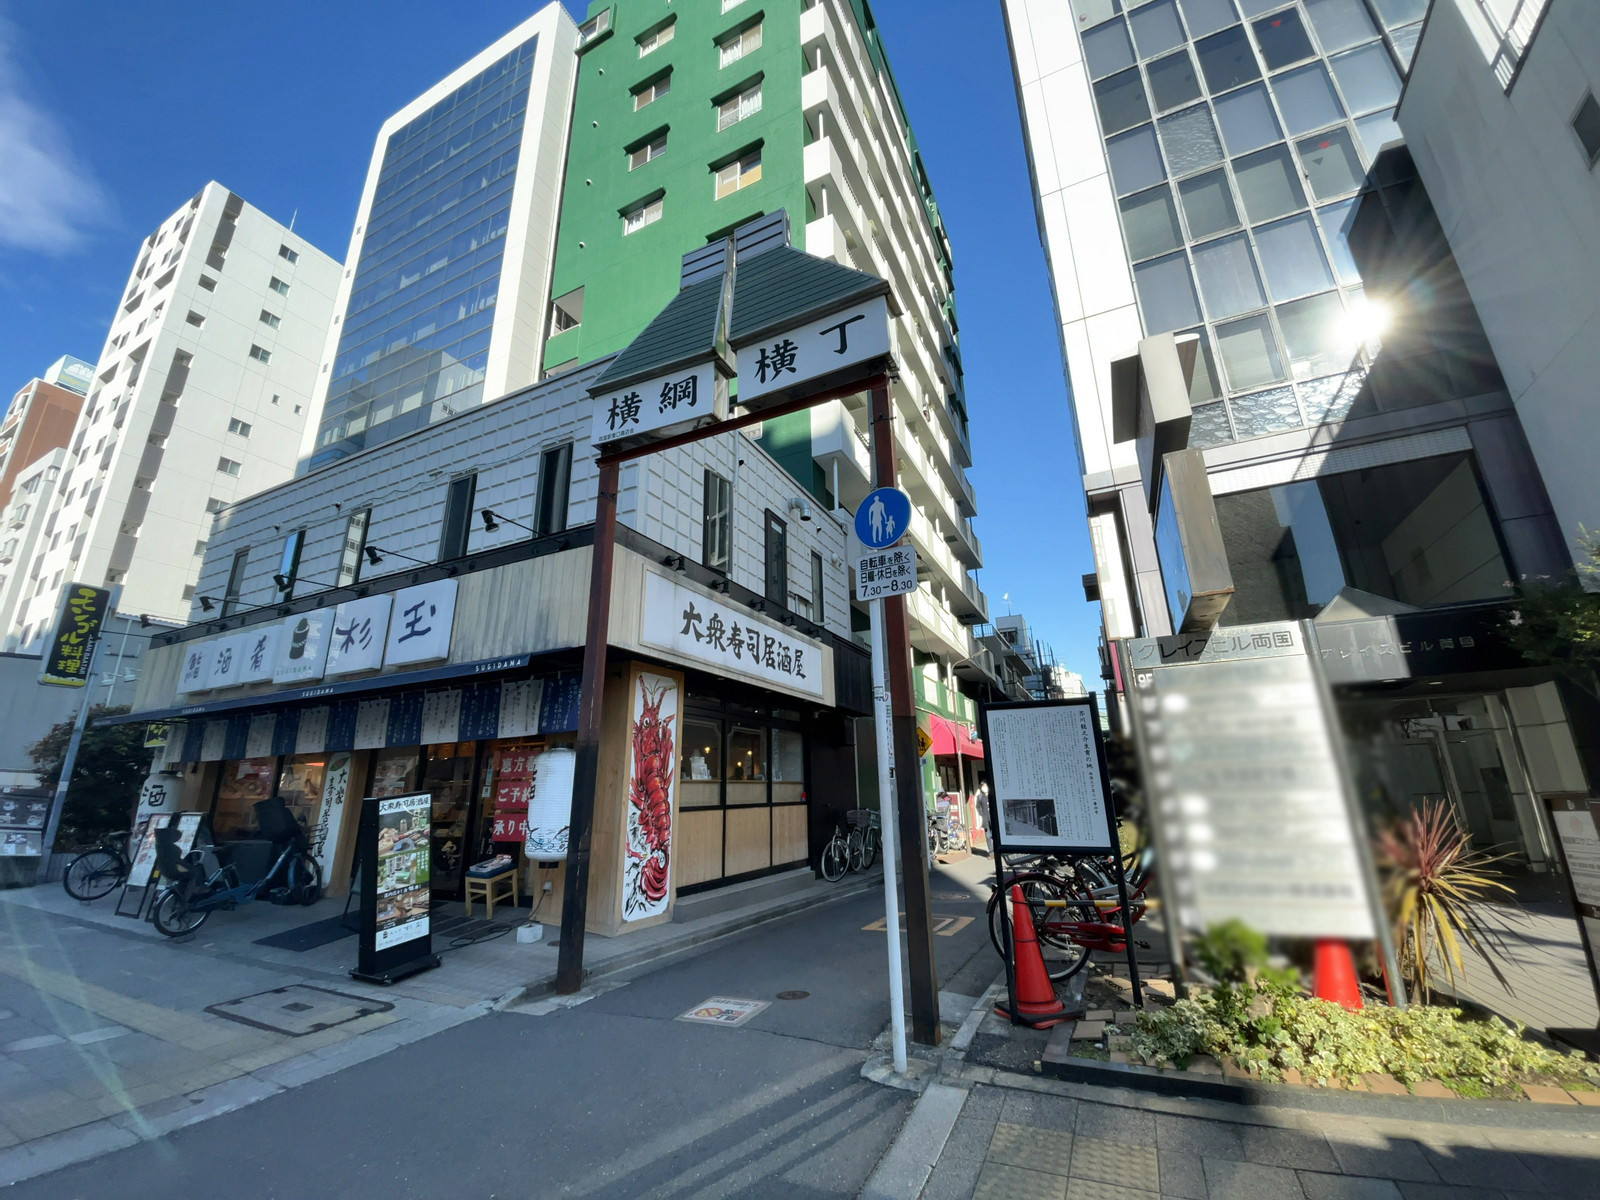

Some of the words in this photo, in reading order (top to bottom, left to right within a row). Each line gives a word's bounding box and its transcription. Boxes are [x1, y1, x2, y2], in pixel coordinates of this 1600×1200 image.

[605, 374, 699, 431] 横綱
[753, 314, 866, 384] 横丁
[860, 551, 911, 571] 自転車を除く
[57, 588, 97, 674] モンゴル料理
[680, 601, 807, 679] 大衆寿司居酒屋
[475, 658, 523, 673] SUGIDAMA
[302, 687, 335, 698] SUGIDAMA
[139, 784, 167, 807] 酒
